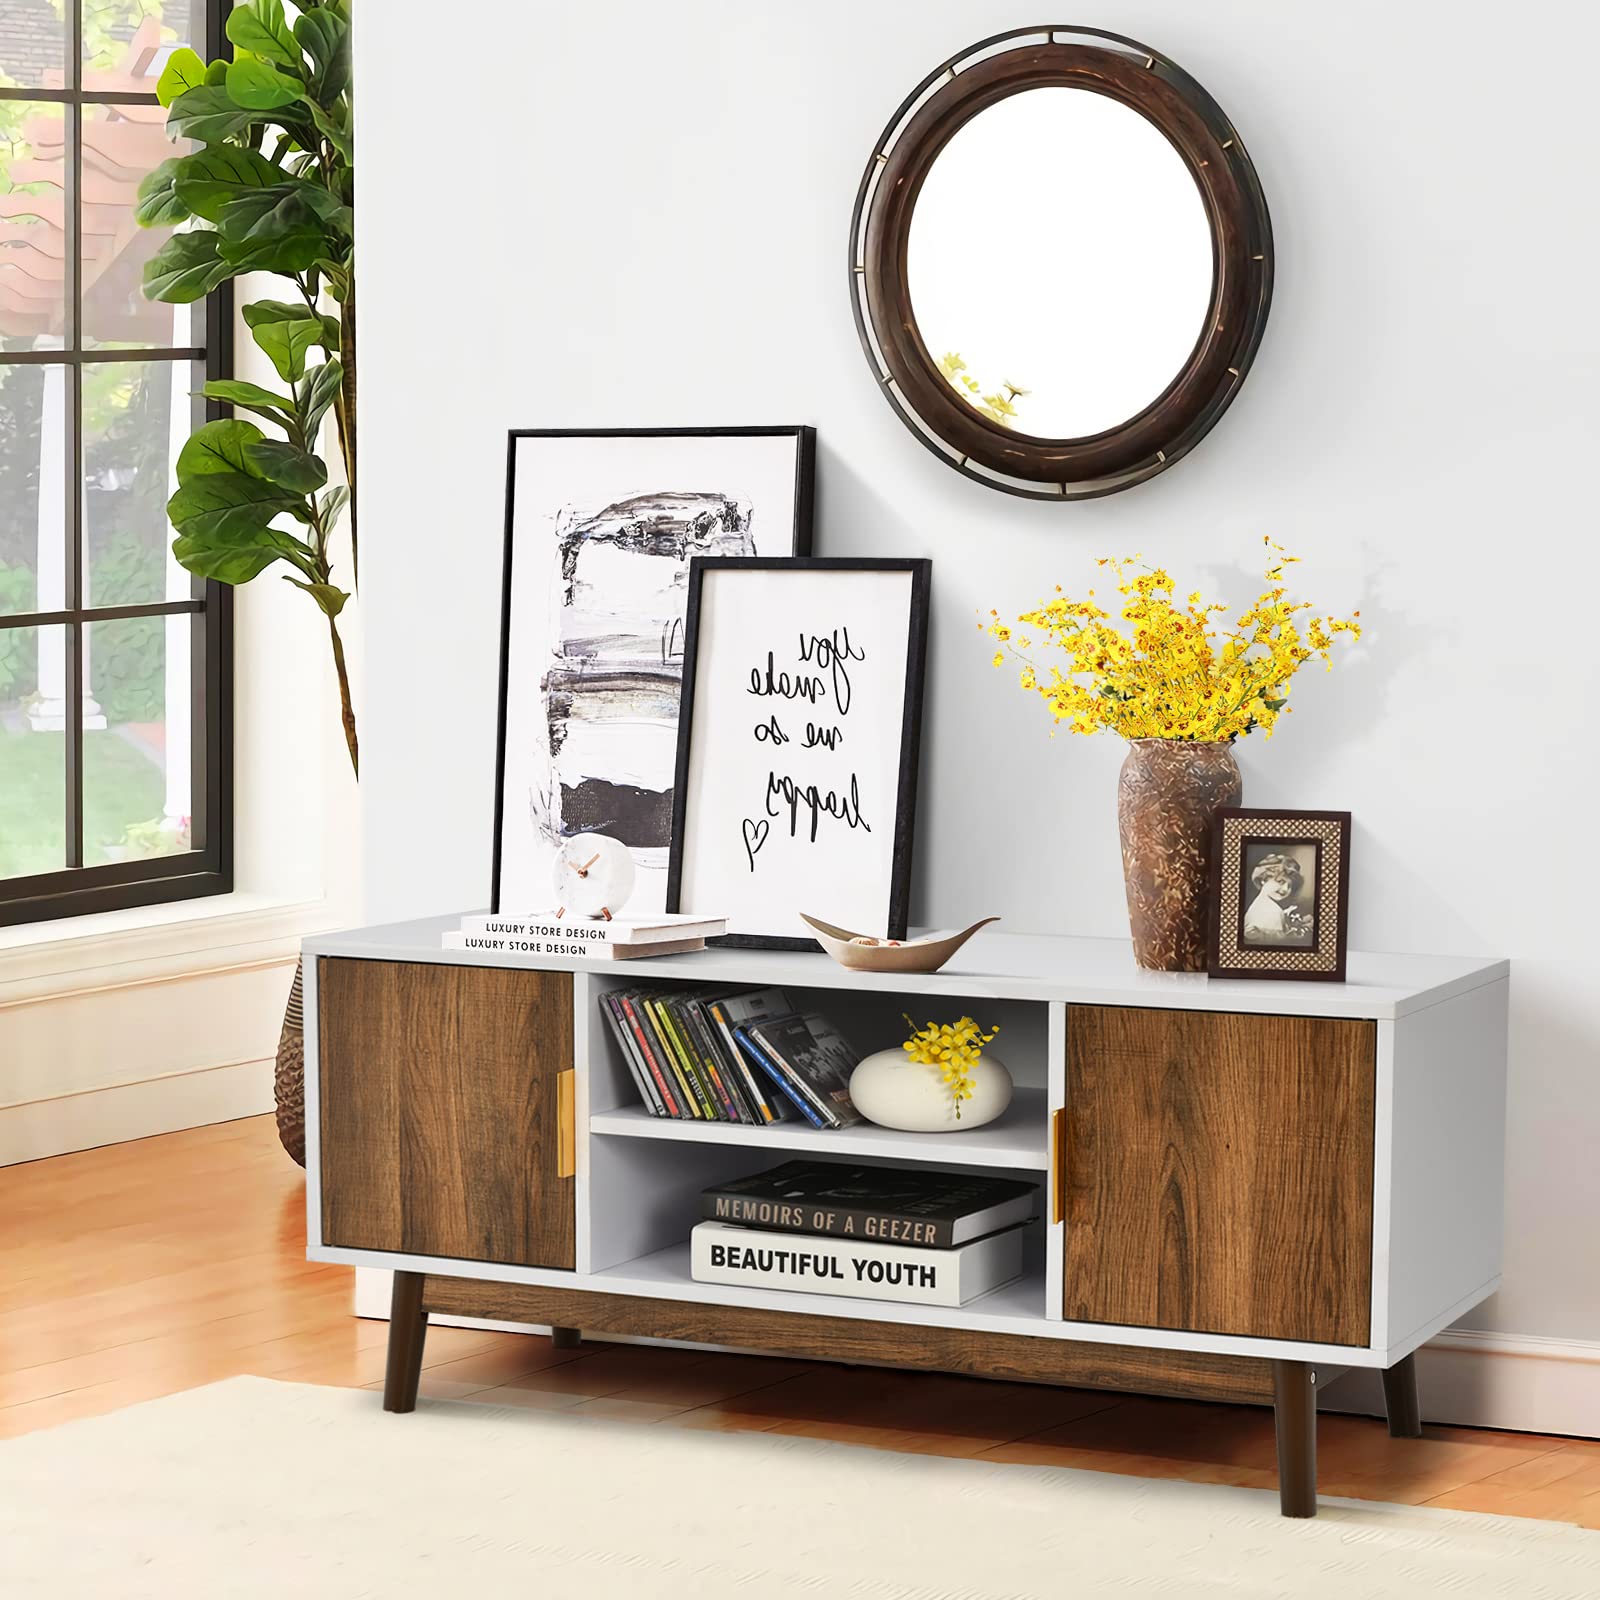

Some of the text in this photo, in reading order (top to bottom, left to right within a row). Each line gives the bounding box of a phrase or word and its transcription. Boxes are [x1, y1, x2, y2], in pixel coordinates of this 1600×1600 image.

[465, 938, 586, 955] LUXURY STORE DESIGN
[486, 923, 606, 940] LUXURY STORE DESIGN
[715, 1198, 937, 1244] MEMOIRS OF A GEEZER
[711, 1245, 936, 1288] BEAUTIFUL YOUTH
